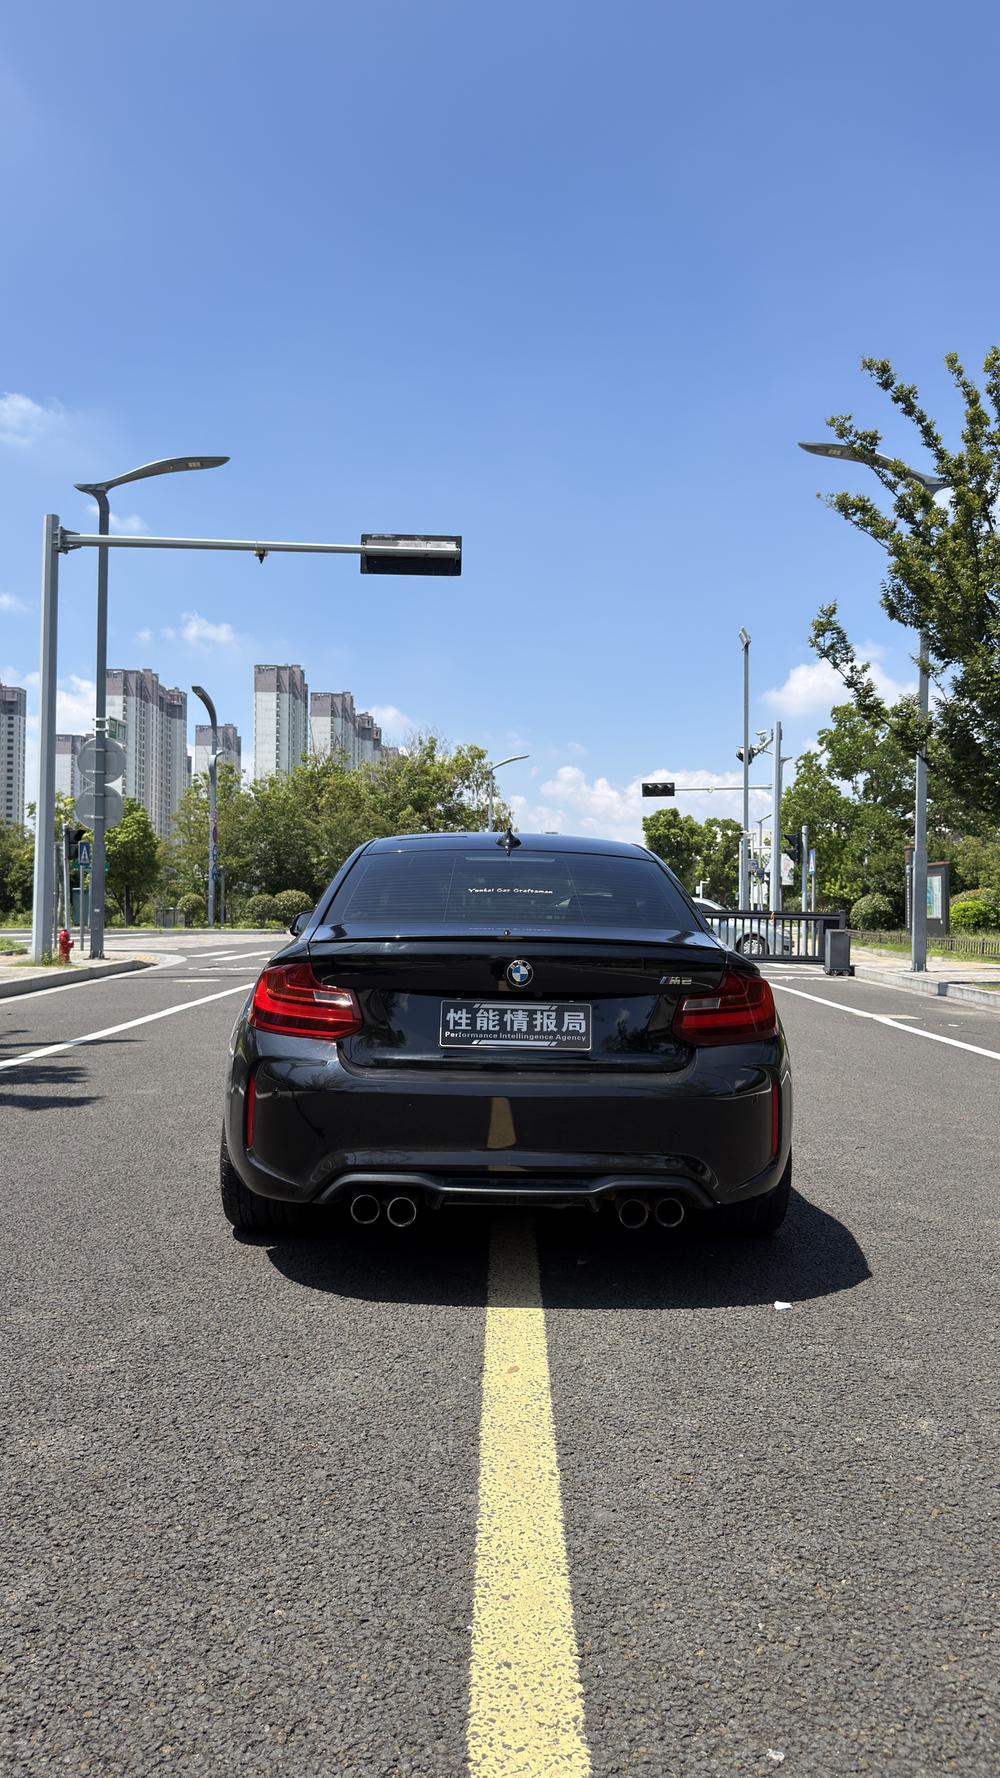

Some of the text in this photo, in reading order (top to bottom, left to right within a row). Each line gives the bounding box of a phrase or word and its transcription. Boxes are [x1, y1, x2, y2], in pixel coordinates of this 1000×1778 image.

[446, 1008, 586, 1033] 性能情报局
[444, 1031, 498, 1039] Performance
